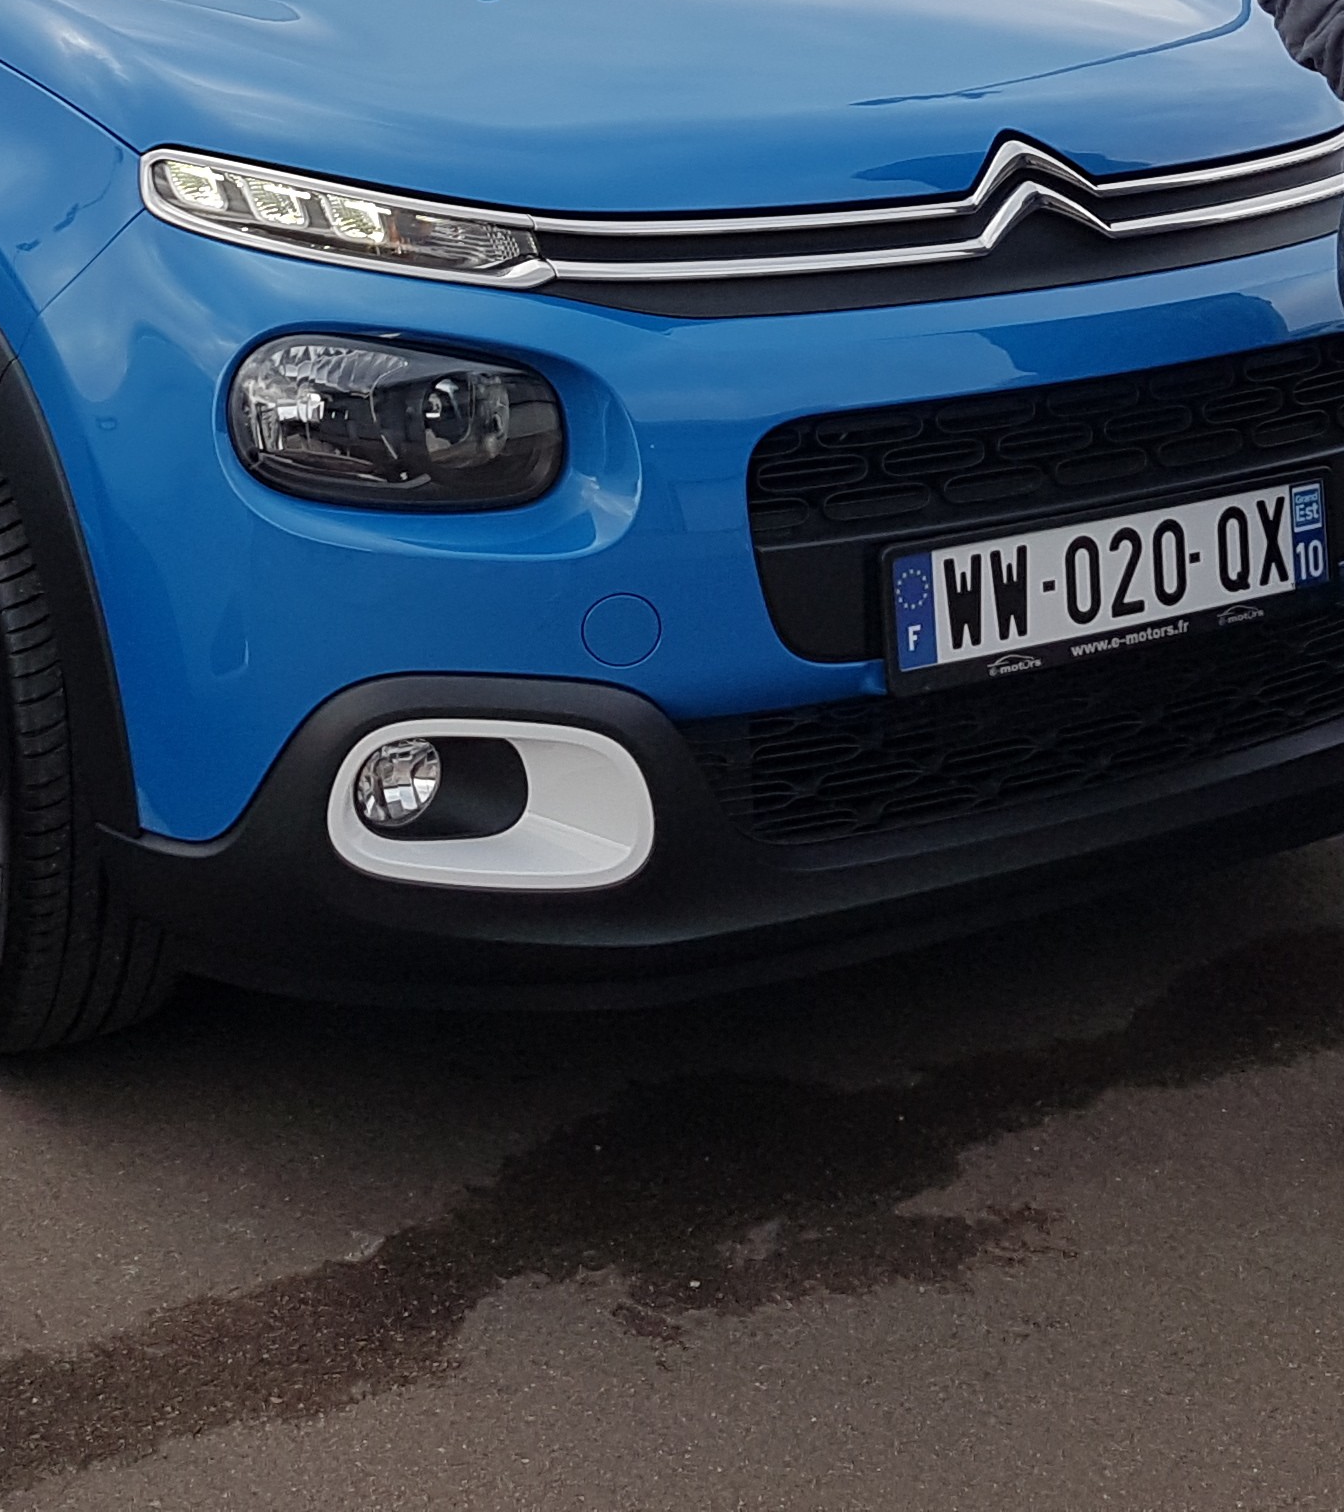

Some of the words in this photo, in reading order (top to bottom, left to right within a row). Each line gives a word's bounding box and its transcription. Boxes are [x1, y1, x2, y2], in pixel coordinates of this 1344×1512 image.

[1295, 490, 1318, 505] Grand
[1295, 502, 1319, 522] Est
[943, 495, 1289, 651] WW-020-QX
[1295, 539, 1324, 581] 10
[907, 624, 922, 652] F
[1070, 618, 1190, 657] www.e-motors.fr
